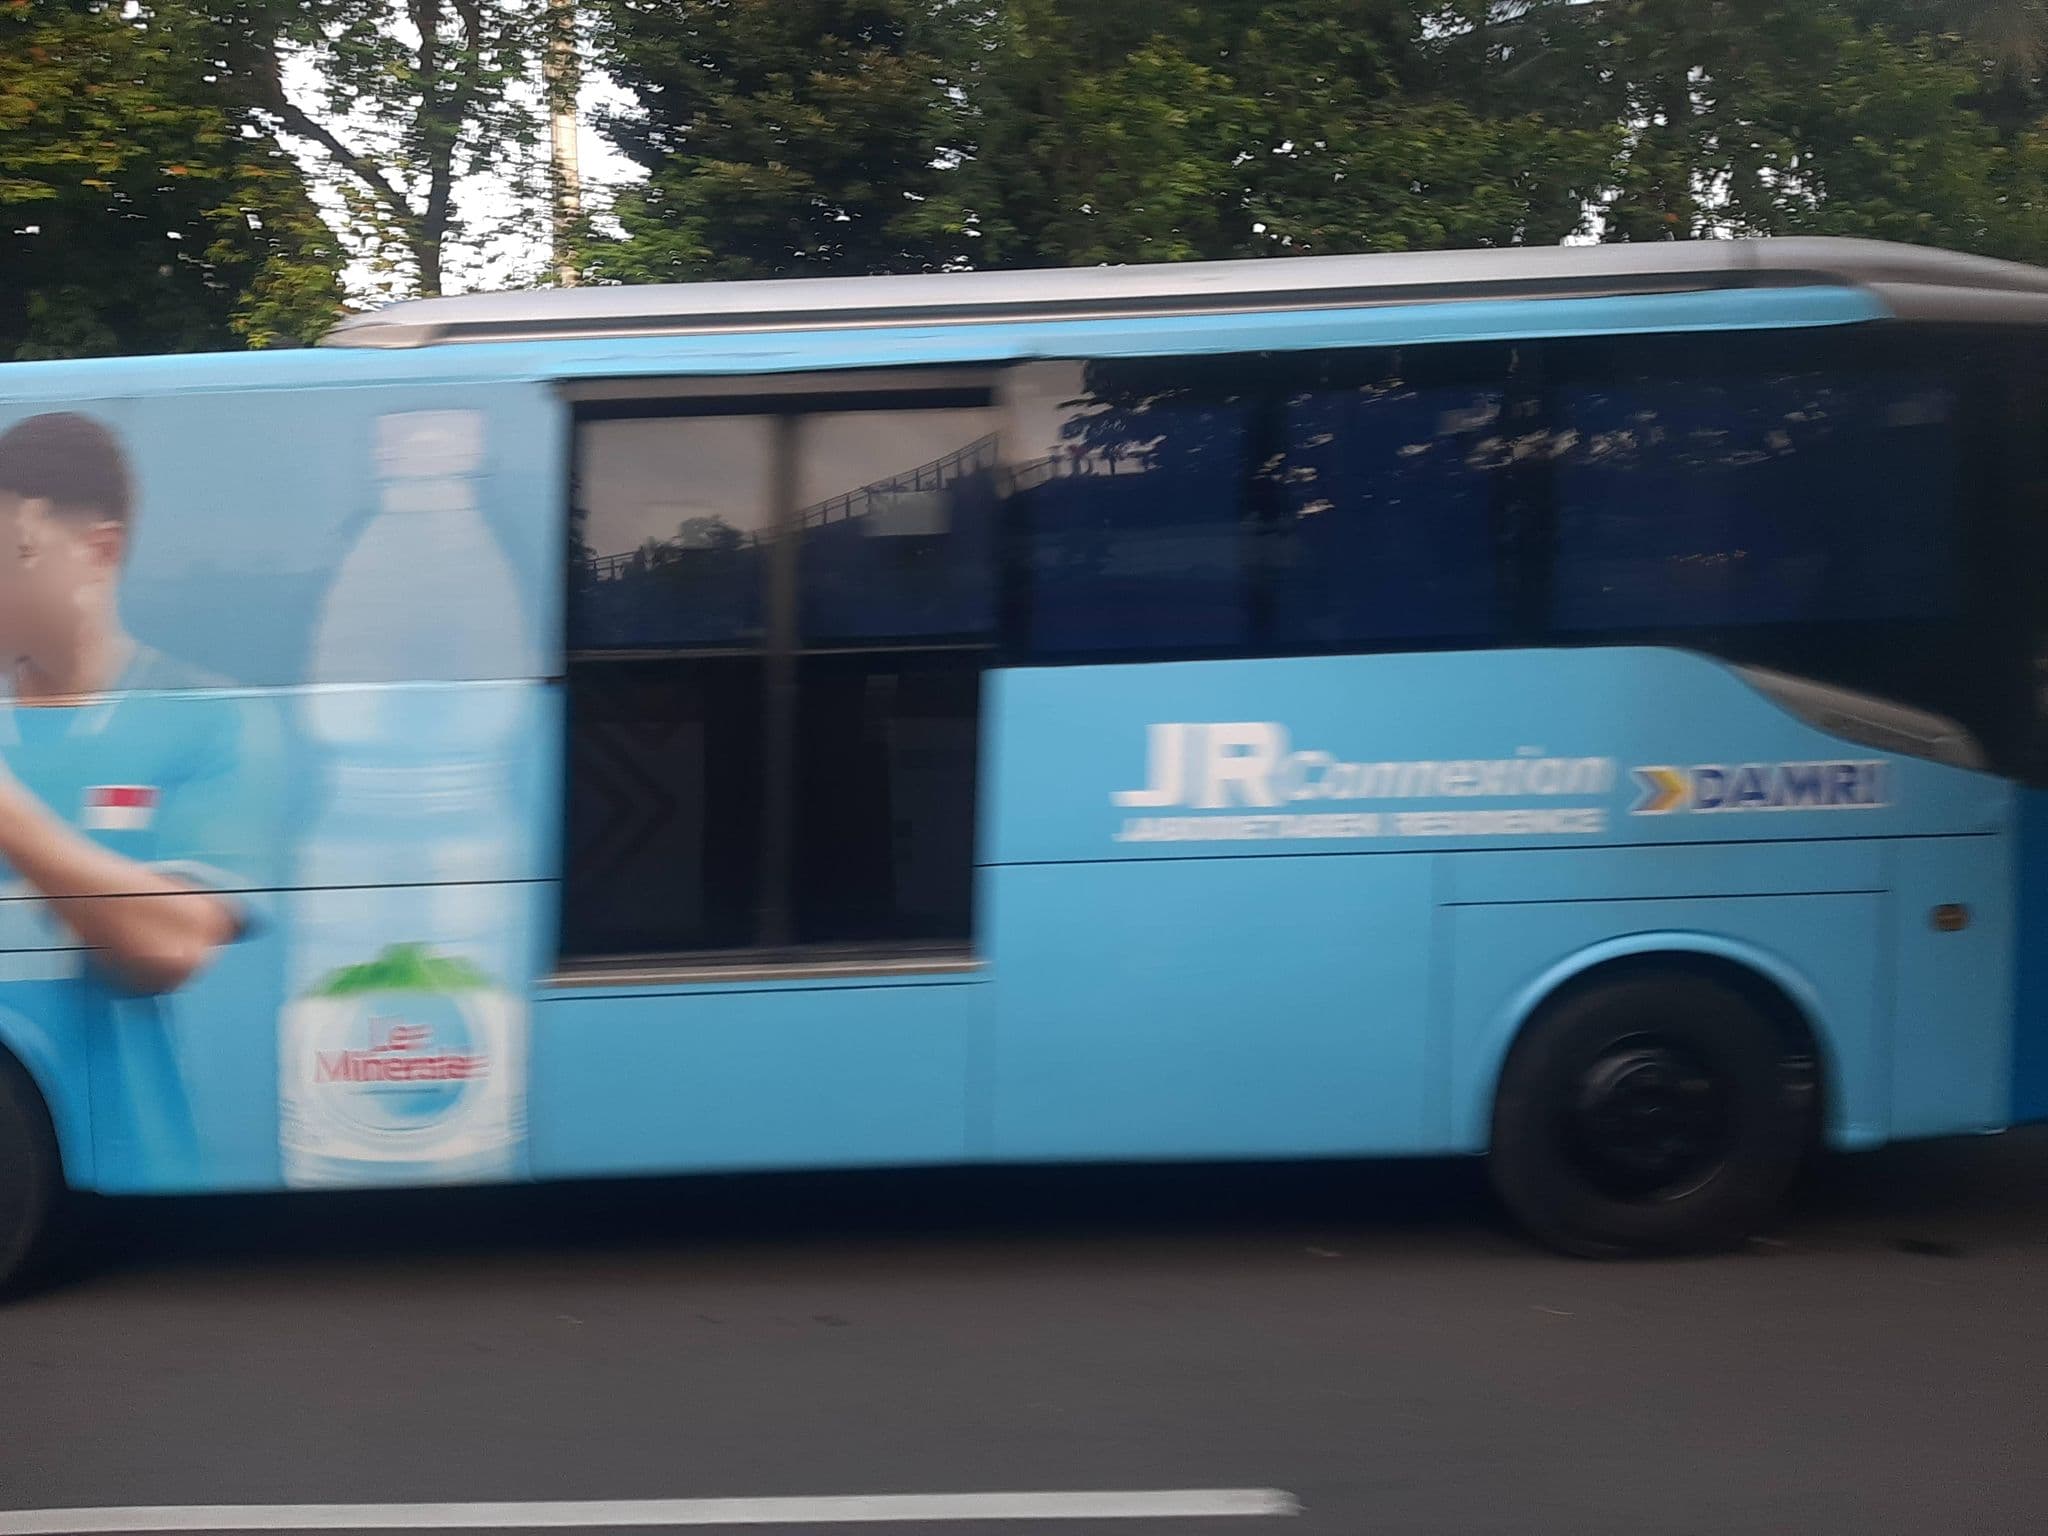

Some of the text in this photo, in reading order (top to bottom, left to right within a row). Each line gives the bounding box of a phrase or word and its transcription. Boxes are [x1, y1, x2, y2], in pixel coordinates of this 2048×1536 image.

[1110, 722, 1612, 808] JR Connexion
[1690, 759, 1886, 812] DAMRI
